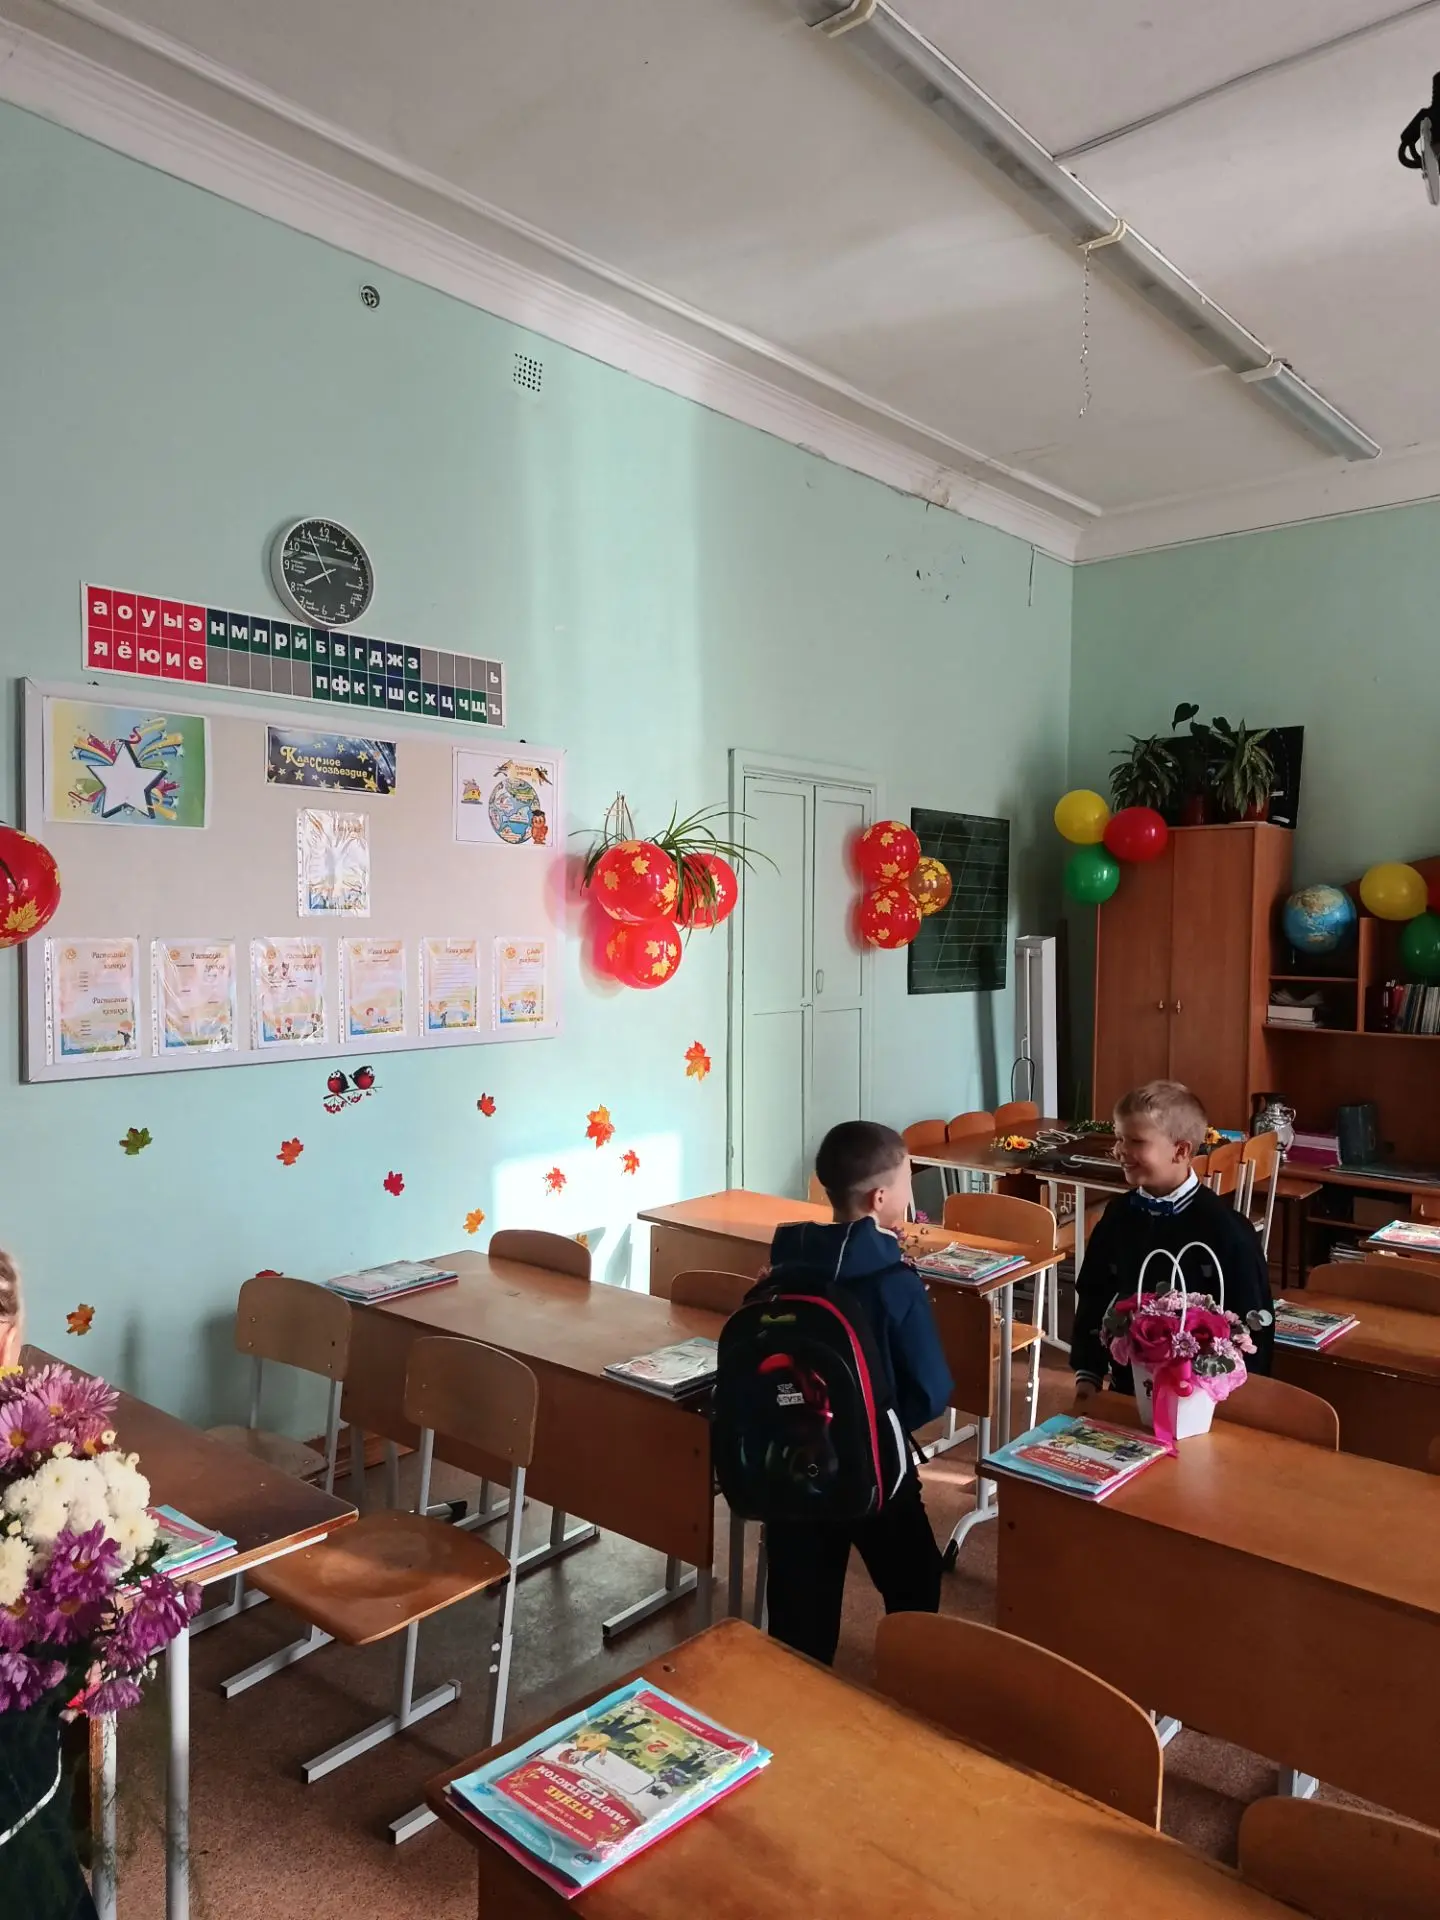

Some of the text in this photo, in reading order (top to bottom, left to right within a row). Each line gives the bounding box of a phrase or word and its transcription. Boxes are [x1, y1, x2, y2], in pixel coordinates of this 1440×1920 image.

[320, 527, 330, 539] 12
[288, 540, 300, 551] 10
[284, 559, 290, 570] 9
[353, 556, 359, 567] 2
[290, 581, 296, 592] 8
[321, 604, 328, 616] 6
[340, 603, 346, 614] 5
[647, 1740, 669, 1753] 2
[580, 1791, 589, 1800] С
[543, 1784, 595, 1821] ЧТЕНИЕ
[589, 1797, 631, 1826] РАБОТА
